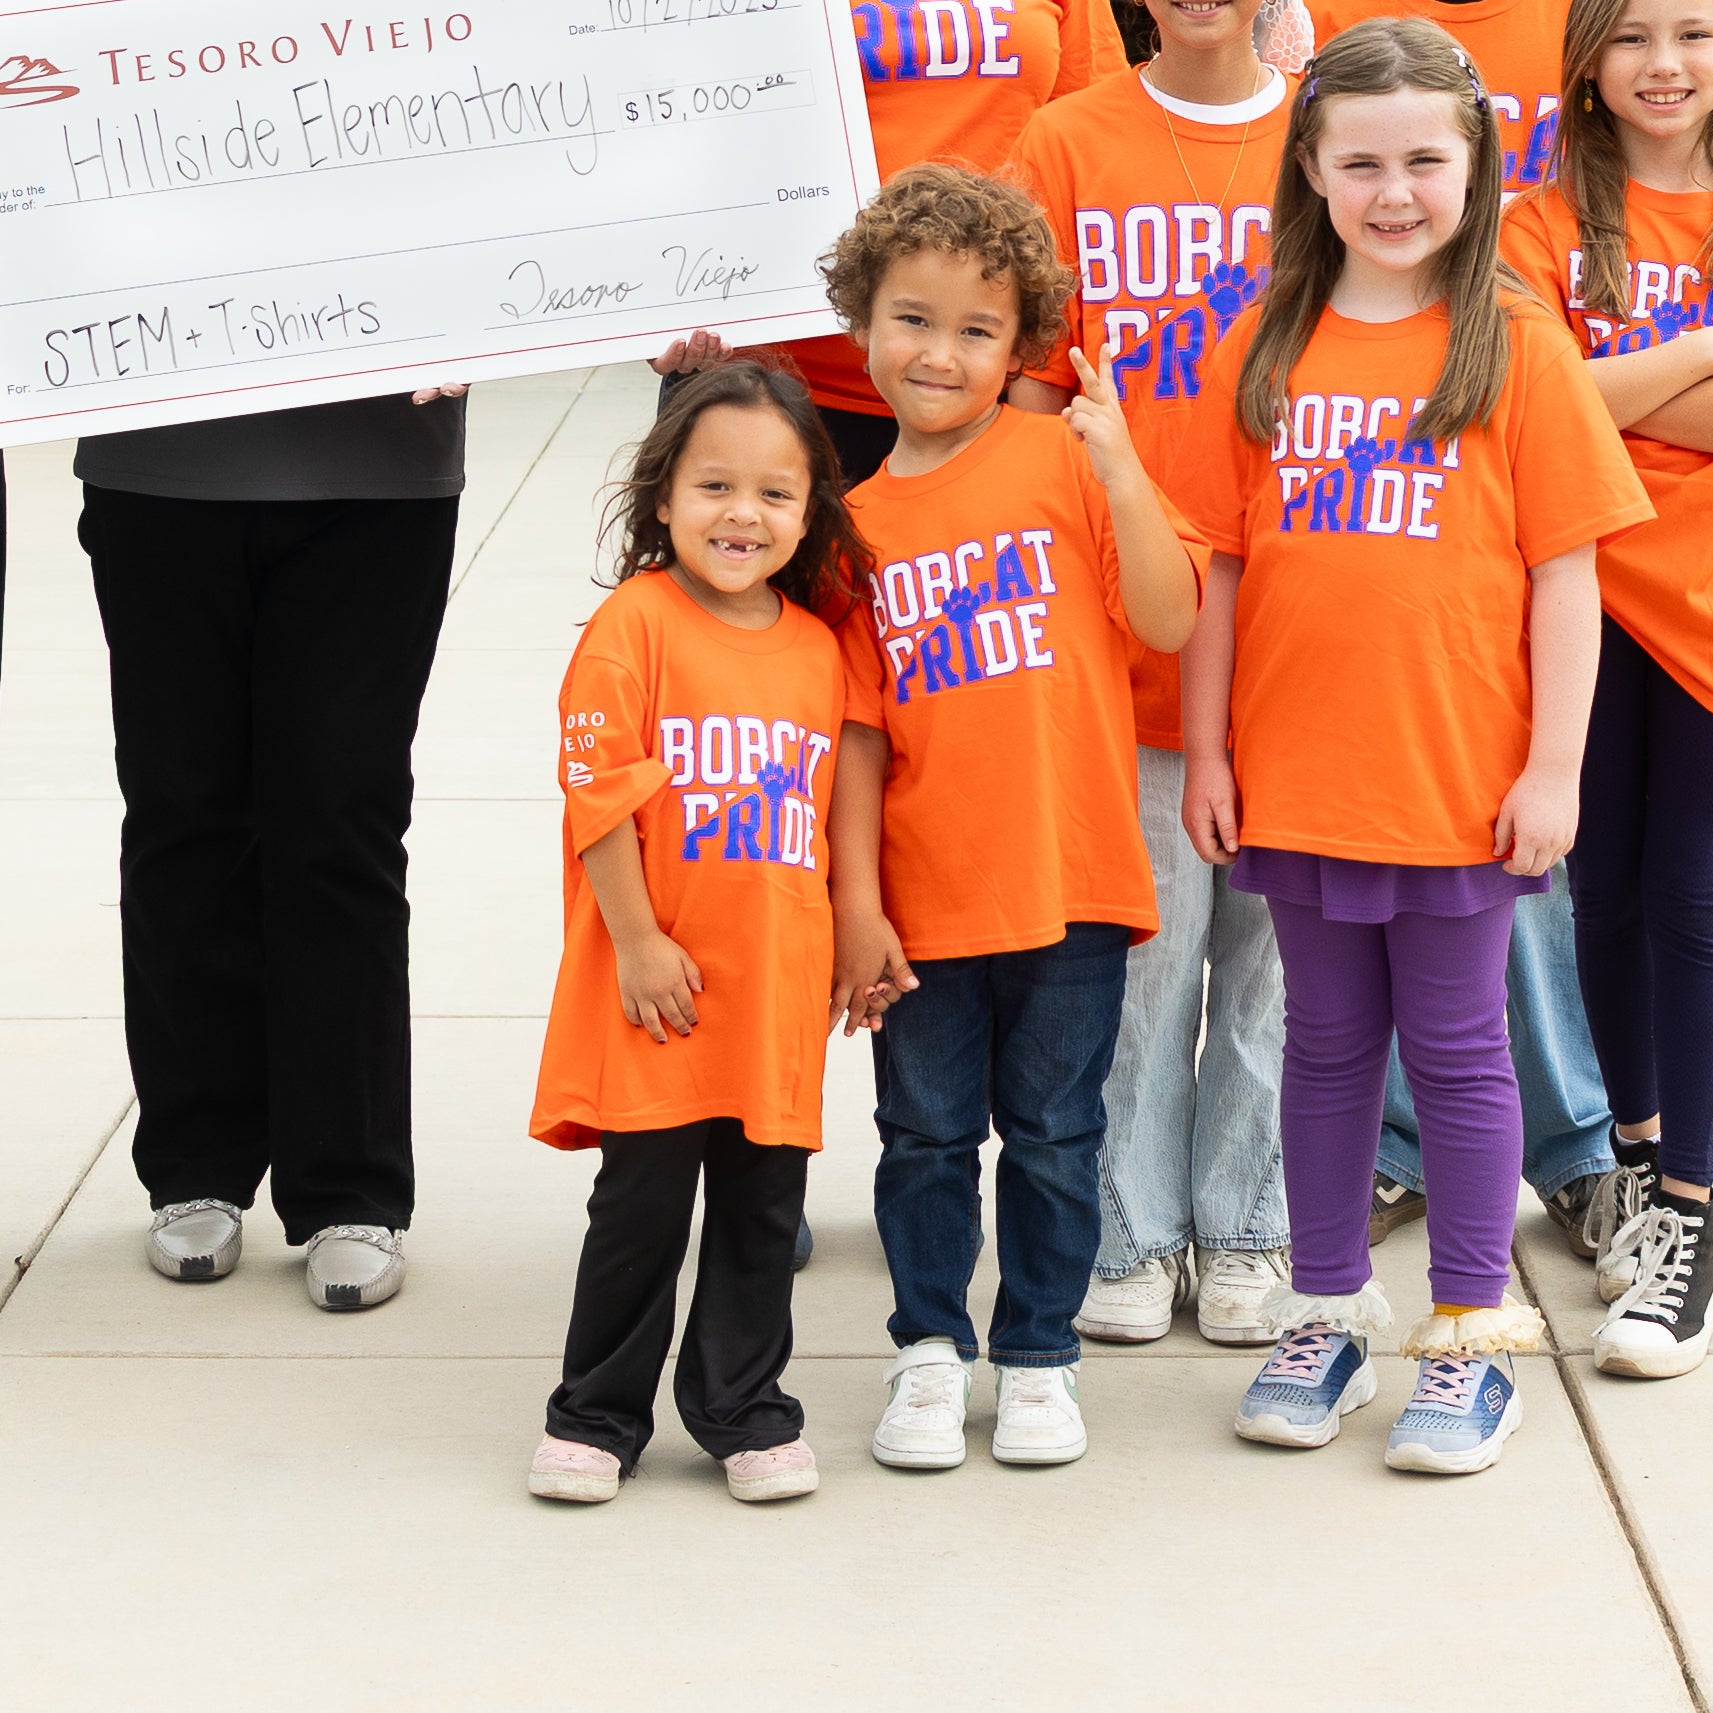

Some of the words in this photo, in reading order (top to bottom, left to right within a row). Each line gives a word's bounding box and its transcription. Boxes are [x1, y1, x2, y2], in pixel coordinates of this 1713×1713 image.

[98, 36, 298, 86] TESORO
[320, 13, 472, 57] VIEJO
[568, 23, 600, 36] Date:
[63, 99, 280, 201] Hillside
[293, 65, 598, 176] Elementary
[11, 188, 23, 198] to
[26, 184, 46, 196] the
[776, 184, 830, 202] Dollars
[661, 245, 760, 301] Viejo
[1076, 202, 1274, 305] BOBC
[44, 306, 179, 387] STEM
[6, 383, 31, 396] For:
[1277, 465, 1446, 541] PRIDE
[867, 527, 1058, 640] BOBCAT
[884, 600, 1056, 705] PRIDE
[565, 711, 606, 730] ORO
[681, 790, 818, 873] PRIDE
